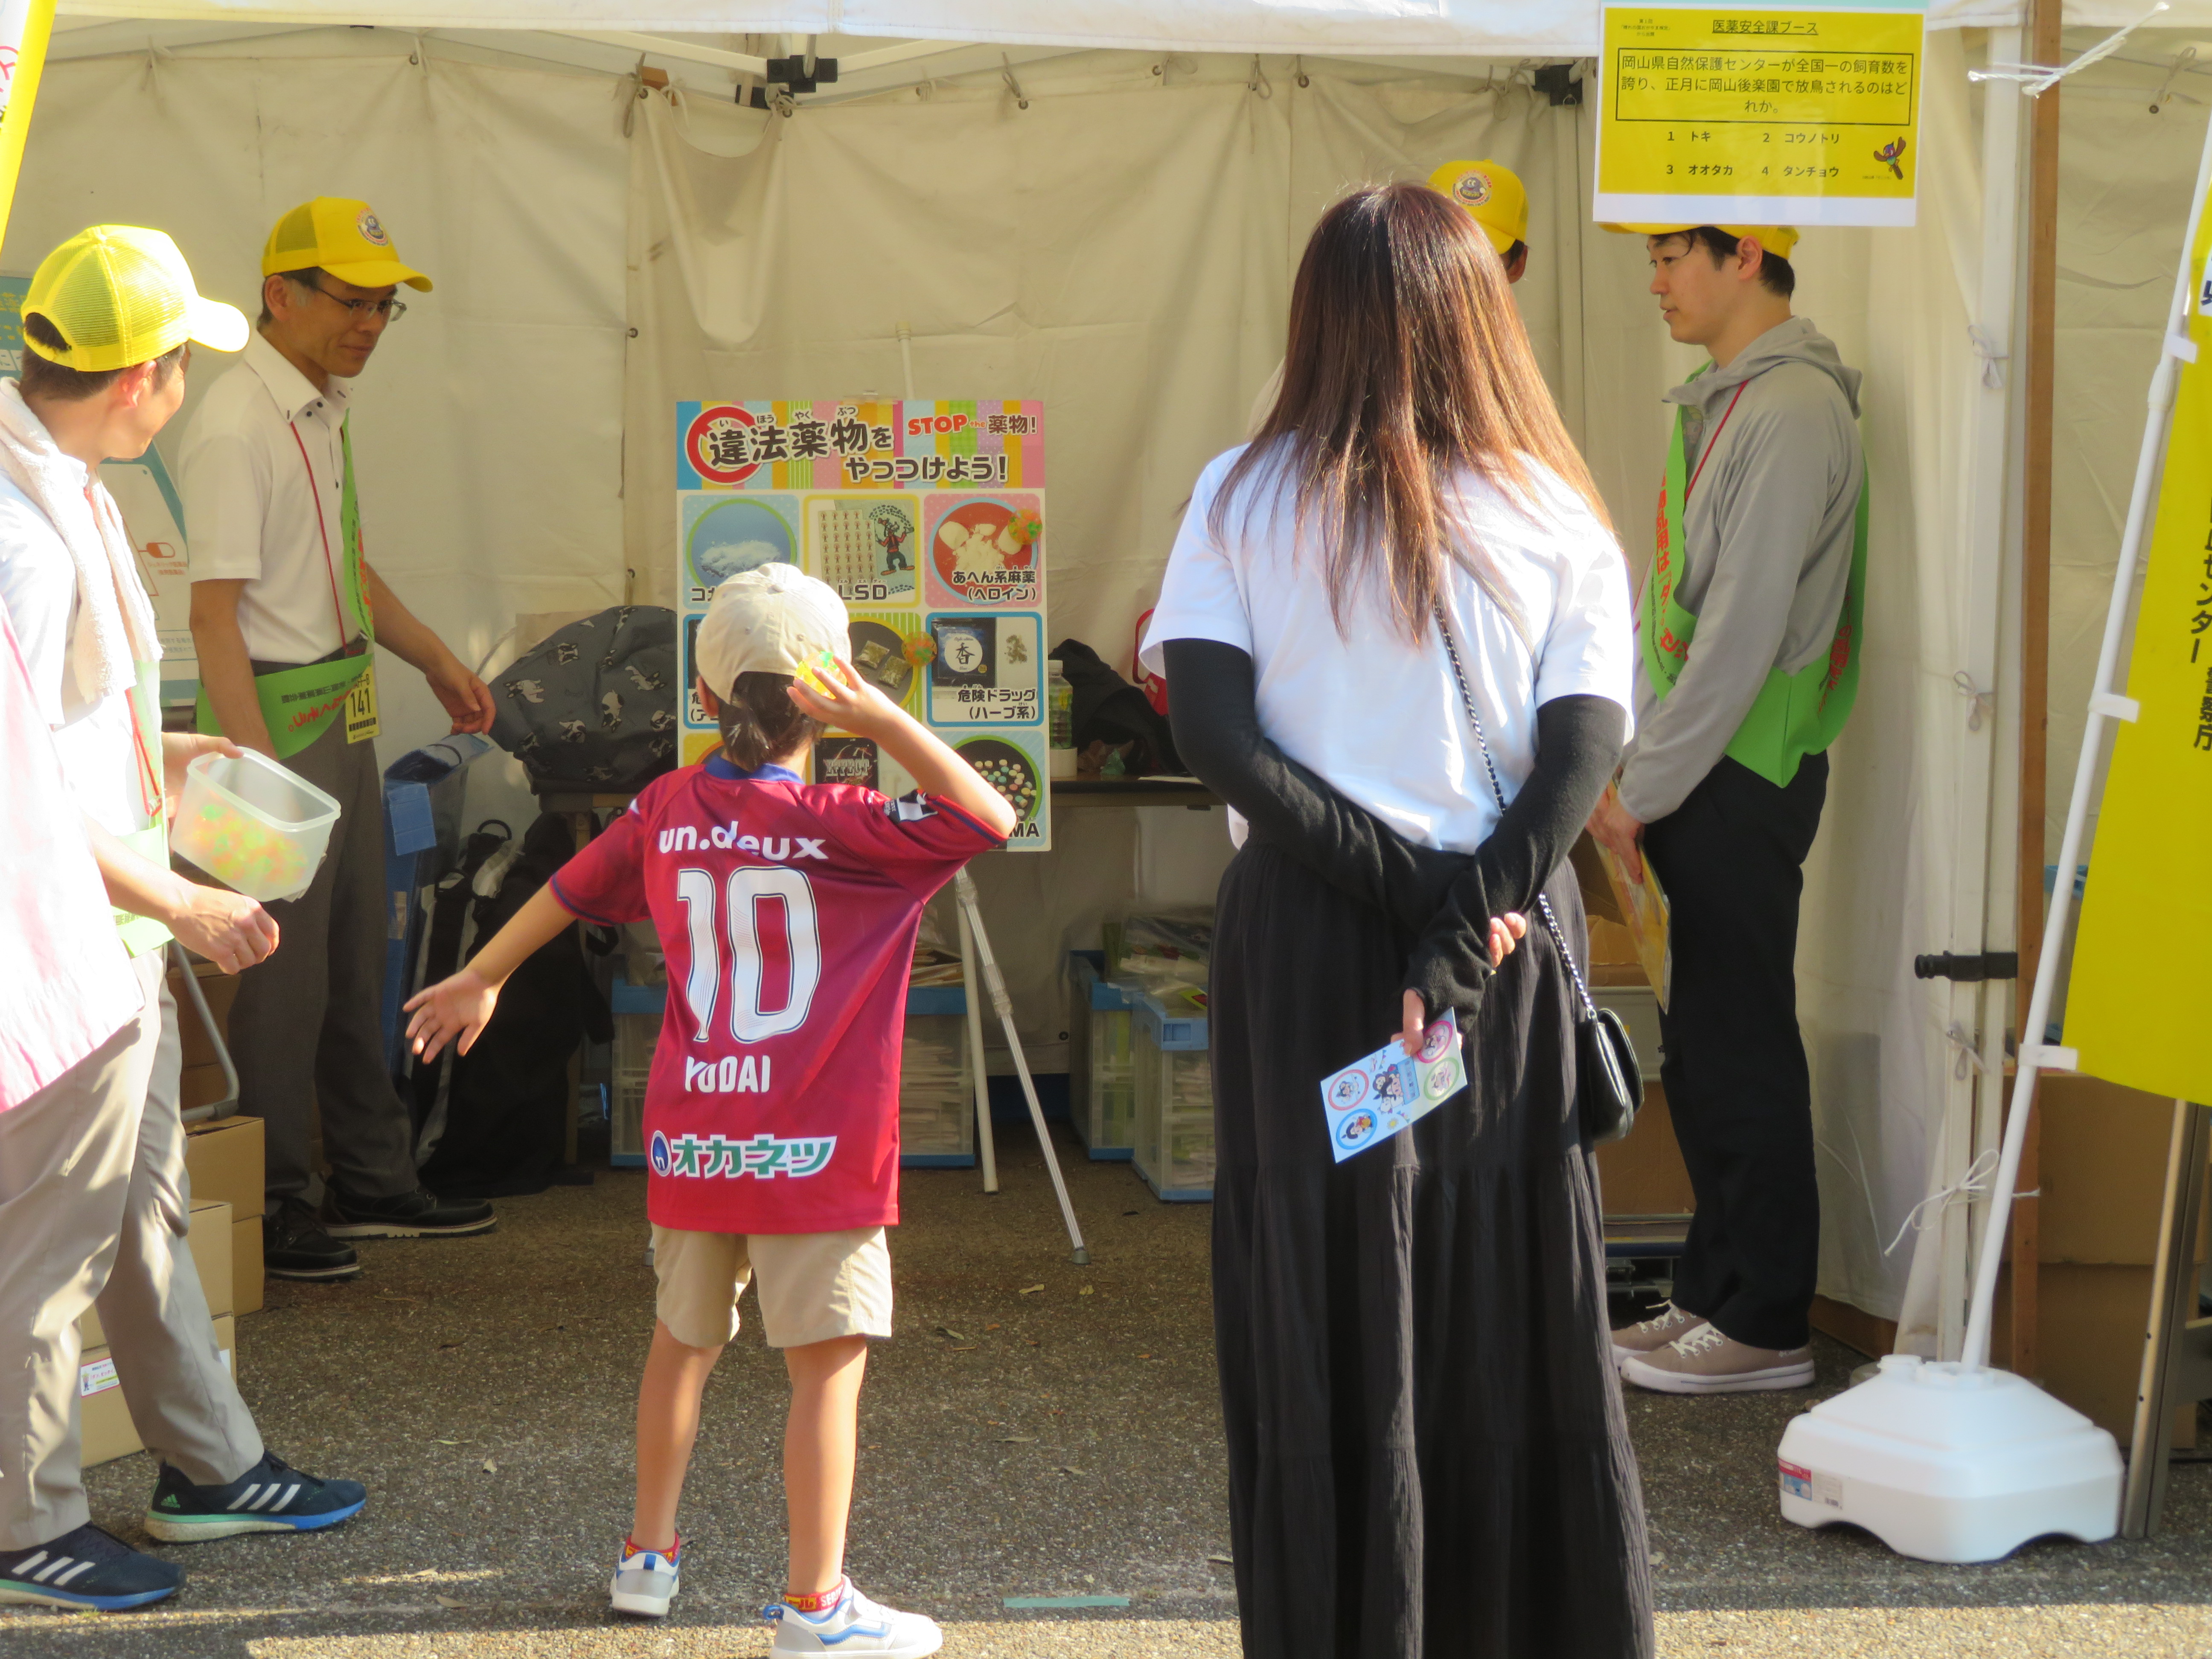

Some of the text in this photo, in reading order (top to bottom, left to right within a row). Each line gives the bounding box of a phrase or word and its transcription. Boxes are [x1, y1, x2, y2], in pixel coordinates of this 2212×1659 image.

[1712, 19, 1818, 35] 医薬安全課ブース
[1621, 55, 1908, 75] 岡山県自然保護センターが全国一の飼育数を
[1621, 76, 1906, 96] 誇り、正月に岡山後楽園で放鳥されるのはど
[1745, 100, 1779, 114] れか。
[1667, 131, 1711, 142] 1 トキ
[1763, 133, 1839, 144] 2 コウノトリ
[1666, 164, 1733, 176] 3 オオタカ
[1762, 165, 1839, 178] 4 タンチョウ
[757, 415, 774, 424] ほう
[795, 410, 810, 419] やく
[837, 407, 856, 416] ぶつ
[908, 414, 969, 436] STOP
[988, 415, 1037, 435] 薬物!
[709, 418, 892, 467] 違法薬物を
[846, 456, 1006, 480] やっつけよう!
[953, 571, 1036, 584] あへん系麻薬
[838, 585, 887, 600] LSD
[968, 587, 1036, 601] (ヘロイン)
[350, 687, 371, 718] 141
[958, 688, 1036, 702] 危険ドラッグ
[969, 705, 1036, 719] (ハーブ系)
[1009, 823, 1040, 837] MA
[659, 820, 828, 861] un.deux
[677, 865, 822, 1044] 10
[671, 1134, 837, 1179] オカネツ
